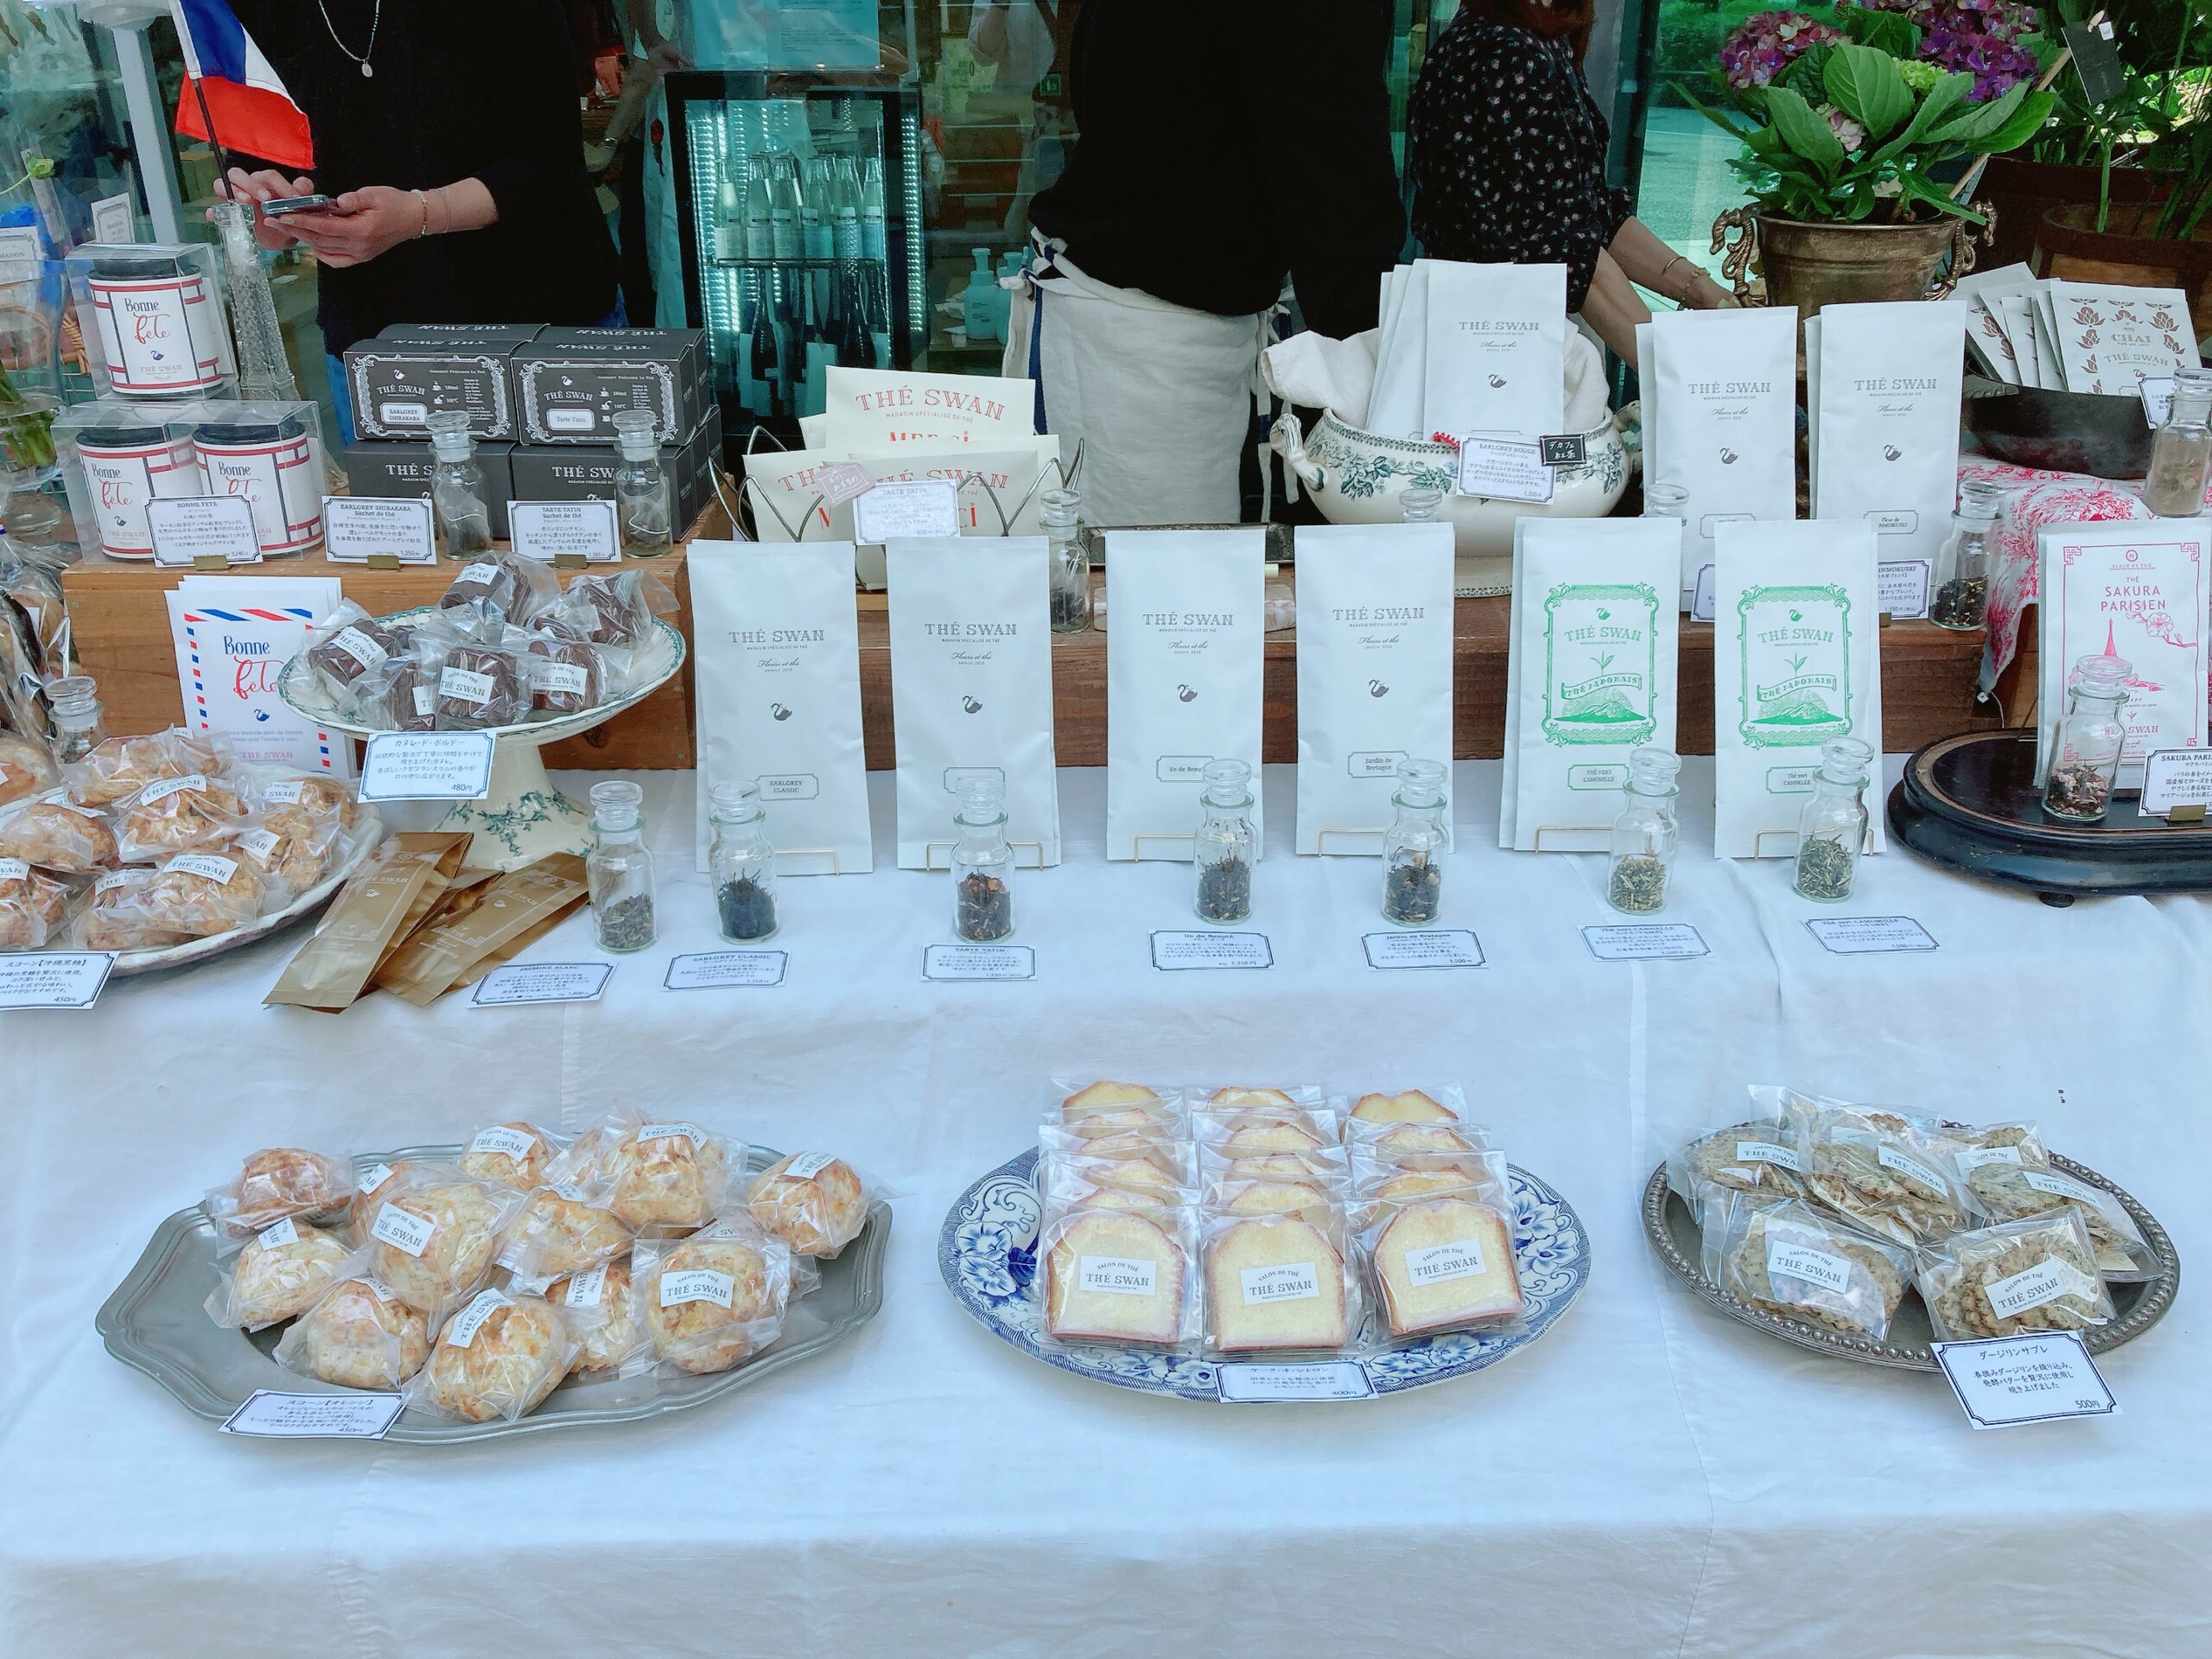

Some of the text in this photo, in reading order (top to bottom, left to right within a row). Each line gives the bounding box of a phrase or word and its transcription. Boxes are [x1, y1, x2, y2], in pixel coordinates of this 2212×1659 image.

[124, 297, 159, 312] Bonne
[1459, 320, 1540, 331] THÉ SWAN
[2112, 334, 2152, 343] CHAI
[2133, 353, 2169, 366] SWAN
[377, 385, 426, 396] THÉ SWAN
[1688, 381, 1772, 394] THÉ SWAN
[1853, 378, 1937, 391] THÉ SWAN
[544, 390, 593, 402] THÉ SWAN
[855, 385, 1006, 421] THÉ SWAN
[1479, 443, 1512, 452] EARLGREY
[1548, 442, 1575, 450] デカフェ
[92, 463, 121, 479] Bonne
[218, 461, 251, 475] Bonne
[385, 462, 417, 475] THÉ
[552, 465, 584, 477] THÉ
[2126, 575, 2139, 583] THÉ
[2105, 585, 2160, 597] SAKURA
[2101, 599, 2166, 612] PARISIEN
[1143, 612, 1233, 626] THÉ SWAN
[1333, 607, 1425, 620] THÉ SWAN
[925, 621, 1017, 635] THÉ SWAN
[1564, 625, 1643, 642] THÉ SWAN
[728, 629, 824, 643] THÉ SWAN
[1758, 626, 1834, 644] THÉ SWAN
[223, 635, 270, 655] Bonne
[555, 677, 581, 688] SWAN
[1588, 677, 1637, 690] JAPONAIS
[1783, 677, 1832, 691] JAPONAIS
[455, 684, 485, 696] SWAN
[195, 863, 226, 878] SWAN
[495, 1141, 523, 1154] SWAN
[391, 1228, 423, 1247] SWAN
[1422, 1249, 1440, 1261] SALON
[1414, 1256, 1478, 1276] THÉ SWAN
[1777, 1256, 1841, 1283] THÉ SWAN
[1086, 1273, 1149, 1287] THÉ SWAN
[1258, 1270, 1276, 1281] SALON
[1249, 1280, 1312, 1295] THÉ SWAN
[2005, 1279, 2021, 1293] SALON
[2023, 1274, 2032, 1284] DE
[666, 1284, 728, 1299] THÉ SWAN
[1998, 1278, 2059, 1310] THÉ SWAN
[1980, 1344, 2048, 1360] ダージリンサブレ
[2008, 1382, 2060, 1394] 焼き上げました
[2075, 1400, 2101, 1408] 500円
